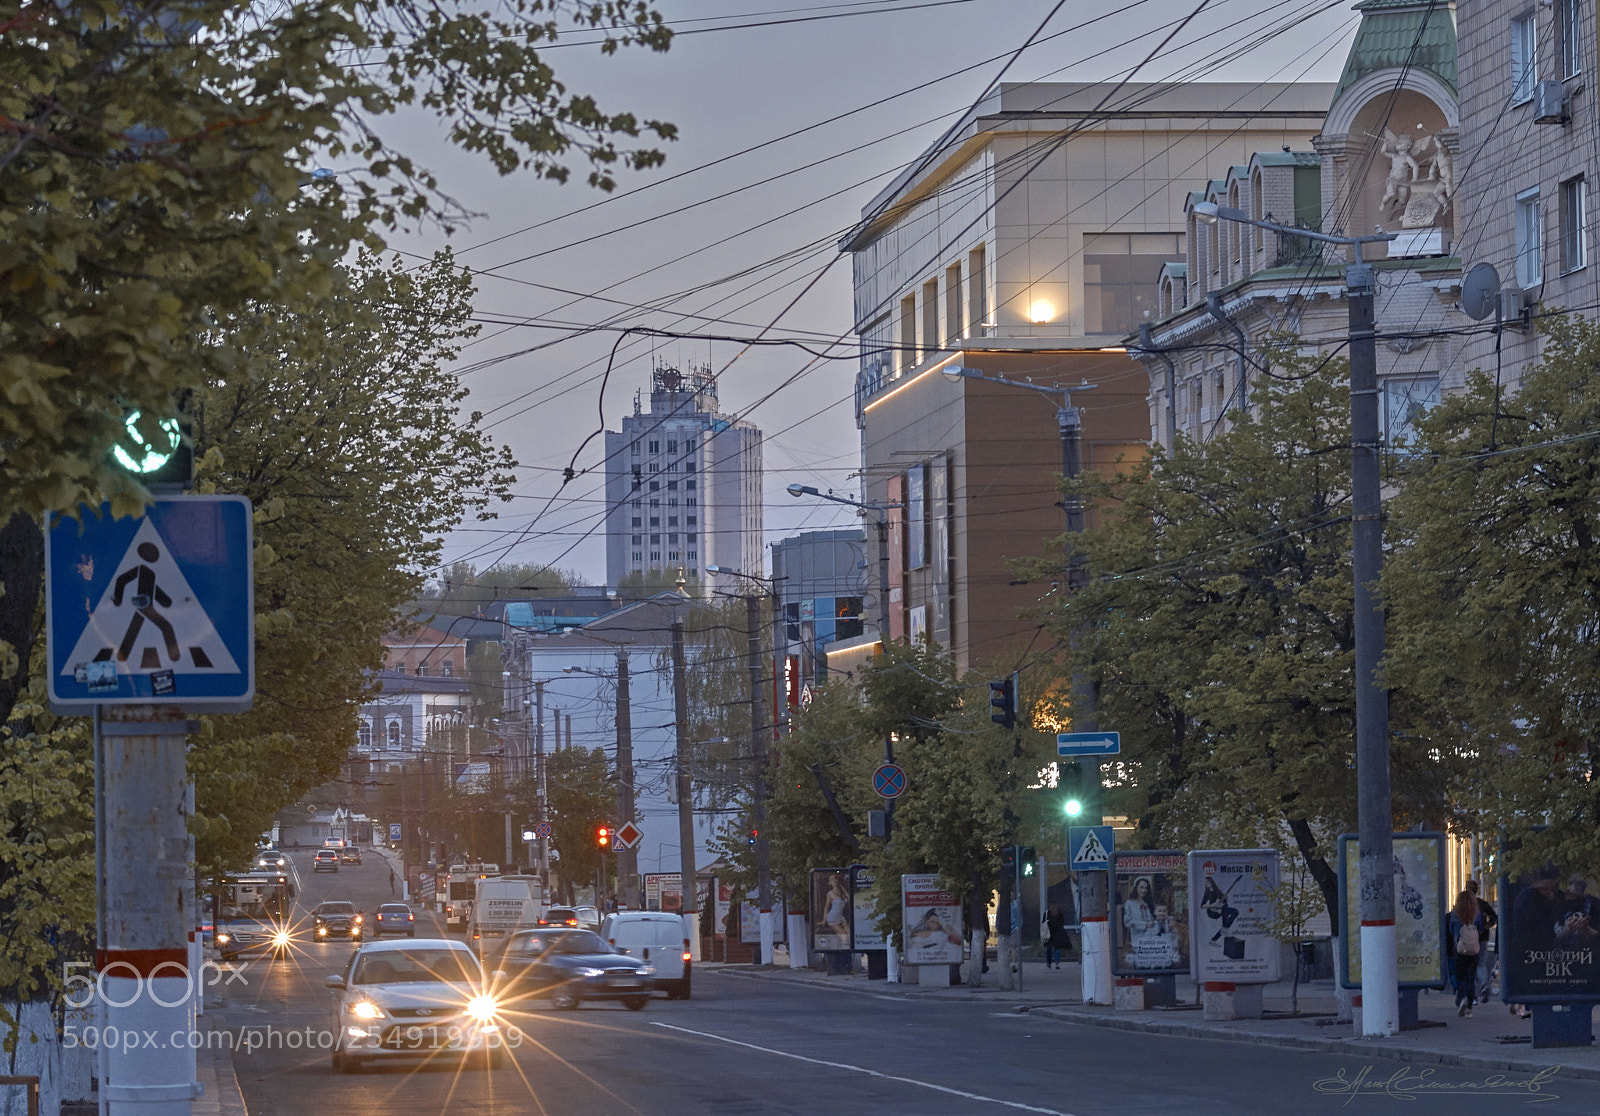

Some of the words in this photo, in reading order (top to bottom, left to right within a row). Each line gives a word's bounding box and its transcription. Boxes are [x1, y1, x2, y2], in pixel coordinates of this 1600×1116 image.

[1117, 856, 1187, 868] ВИШИВАНКИ
[1220, 865, 1243, 874] Music
[1245, 864, 1267, 873] Brnd
[1397, 956, 1432, 965] ОЛОТО
